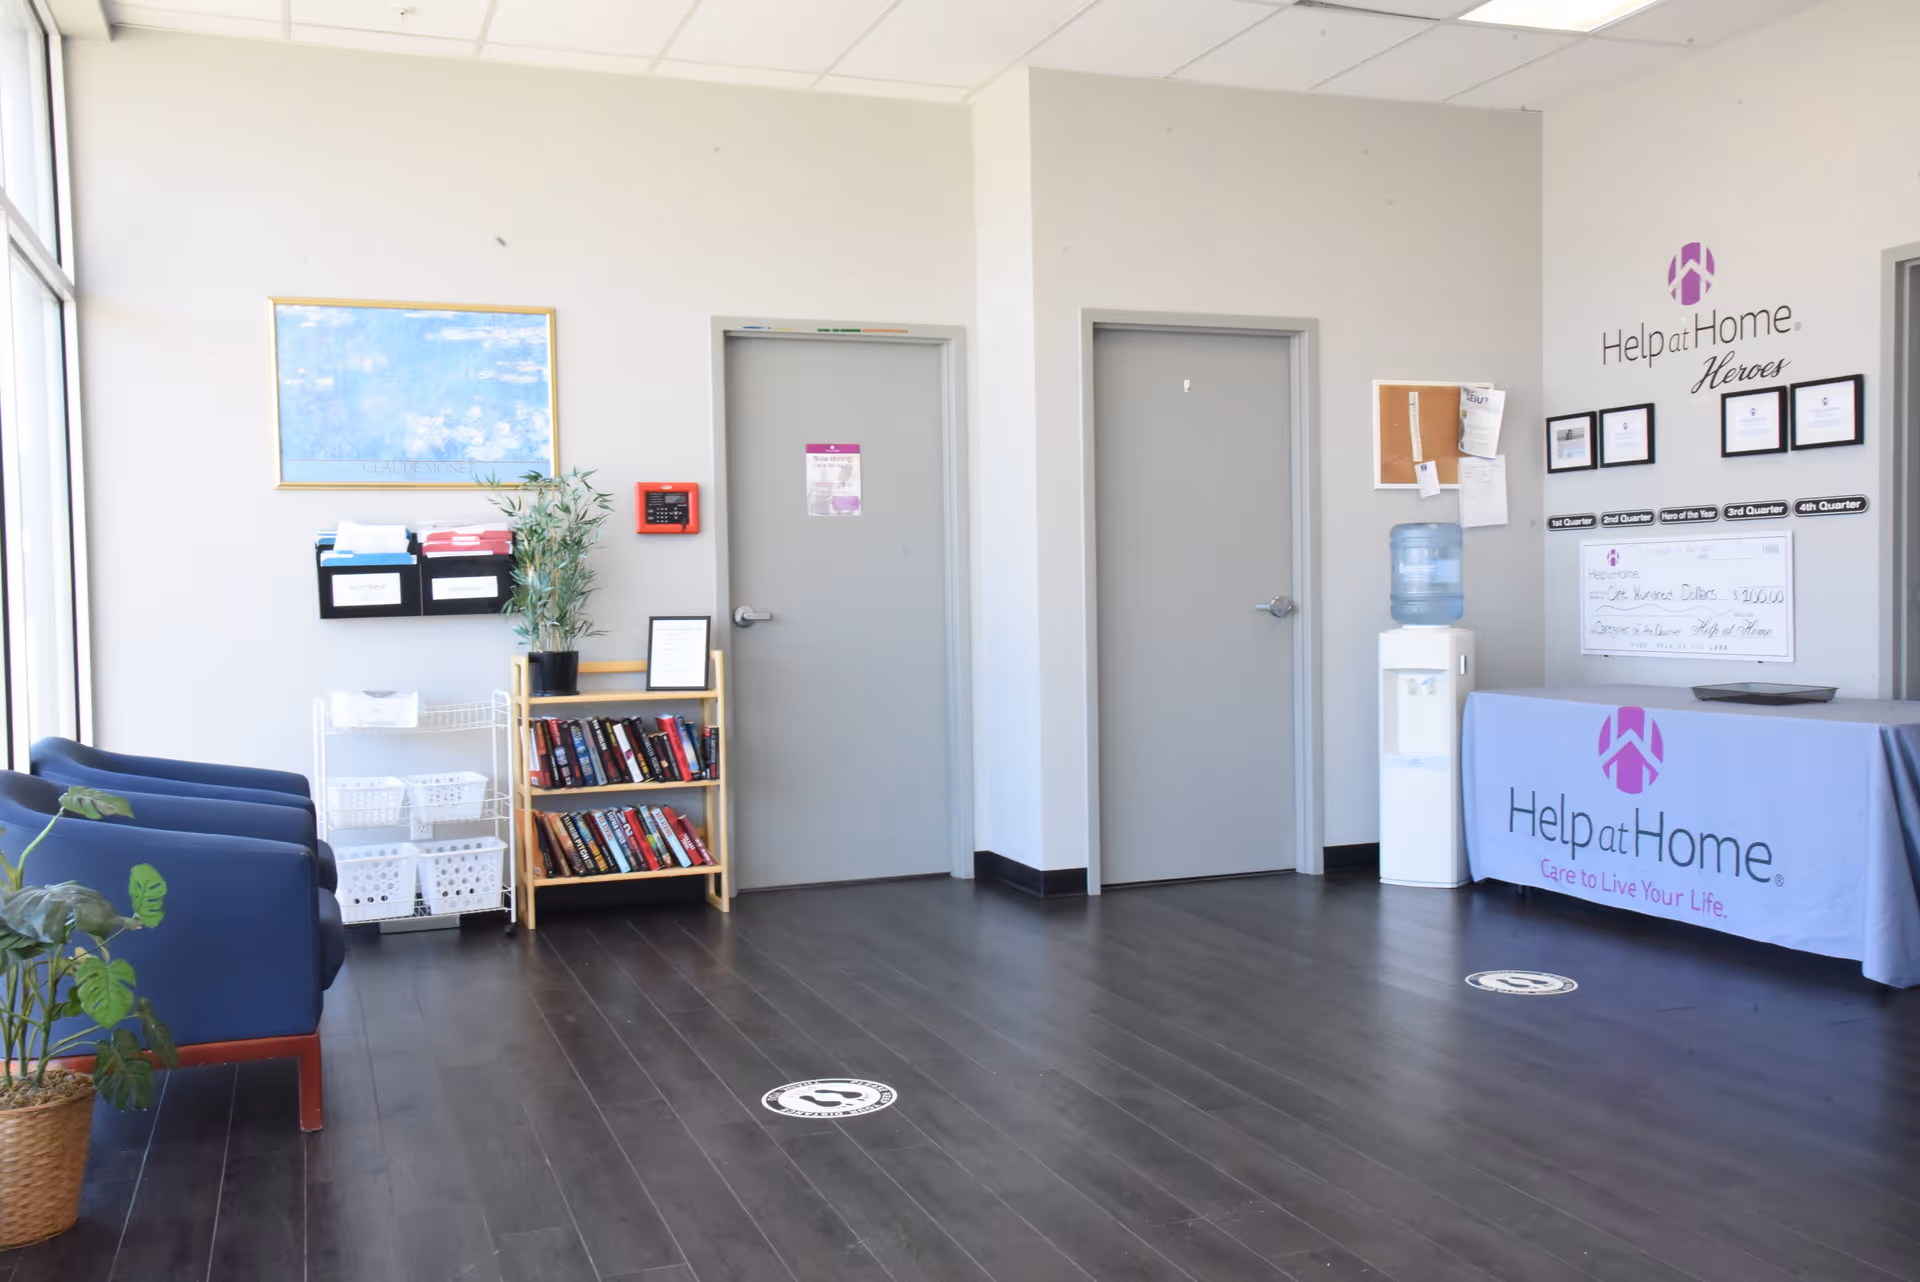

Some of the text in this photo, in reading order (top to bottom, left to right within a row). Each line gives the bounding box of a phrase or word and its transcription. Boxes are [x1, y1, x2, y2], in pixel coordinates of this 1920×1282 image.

[1603, 305, 1792, 368] Help at Home
[1691, 351, 1791, 394] Heroes
[363, 462, 421, 474] CLAUDE
[1728, 505, 1784, 516] 3rd Quarter
[1800, 500, 1861, 511] 4th Quarter
[1604, 513, 1652, 524] 2nd Quarter
[1661, 509, 1716, 520] Hero of the Year
[1552, 517, 1593, 527] 1st Quarter
[1509, 787, 1773, 883] Help at Home
[573, 837, 590, 860] PITCH
[1541, 858, 1728, 919] Care to Live Your Life.
